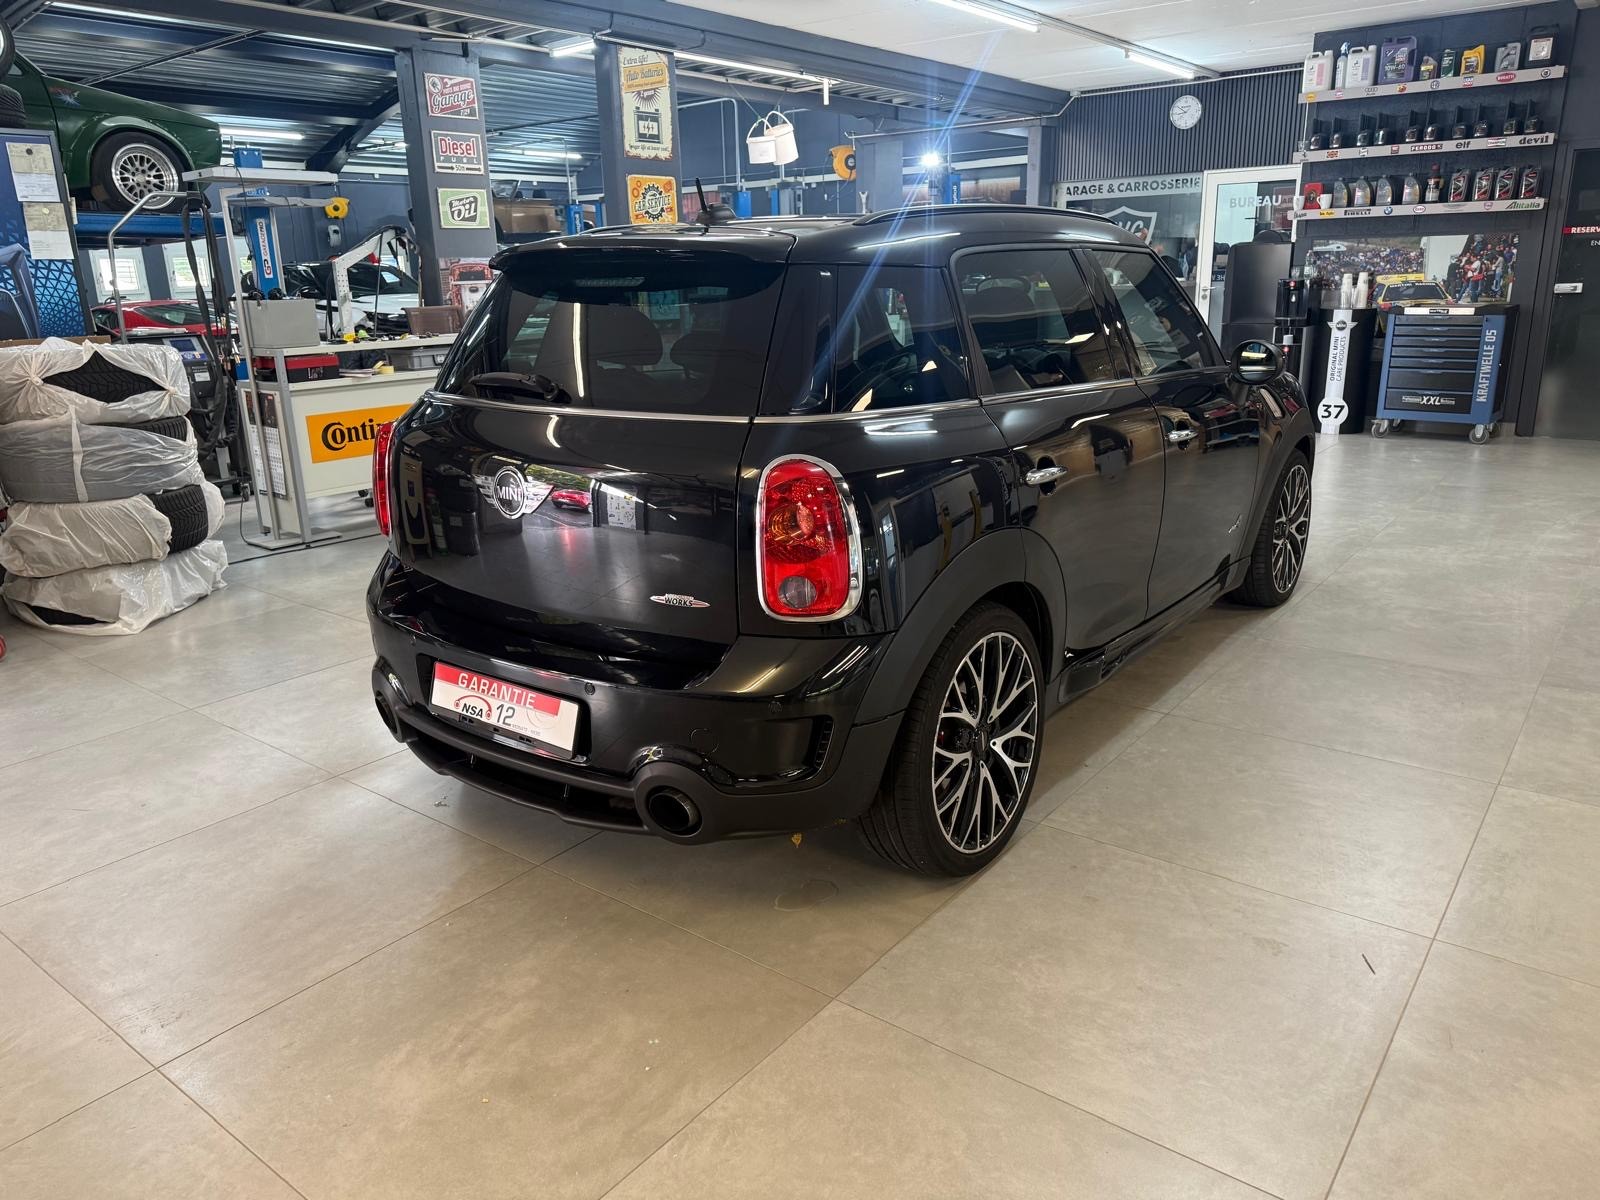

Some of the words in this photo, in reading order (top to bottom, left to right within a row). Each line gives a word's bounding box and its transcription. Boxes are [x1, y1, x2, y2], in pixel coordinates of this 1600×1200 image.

[432, 89, 475, 113] Garage
[438, 136, 478, 158] Diesel
[1455, 141, 1472, 149] elf
[1518, 136, 1550, 145] devil
[1066, 184, 1104, 197] ARAGE
[1107, 183, 1116, 194] &
[635, 200, 647, 212] CAR
[648, 195, 672, 209] SERVICE
[1230, 195, 1282, 209] BUREAU
[1505, 201, 1541, 210] Alitalia
[451, 202, 477, 221] Oil
[1571, 226, 1600, 235] RESERV
[1485, 329, 1497, 342] 05
[1330, 352, 1338, 382] ORIGINAL
[1476, 344, 1495, 402] KRAFTWELLE
[1421, 395, 1440, 405] XXL
[1321, 404, 1345, 419] 37
[321, 418, 381, 452] Conti
[497, 485, 523, 501] MINI
[664, 597, 693, 607] WORKS
[458, 672, 537, 709] GARANTIE
[461, 703, 484, 719] NSA
[496, 703, 516, 727] 12
